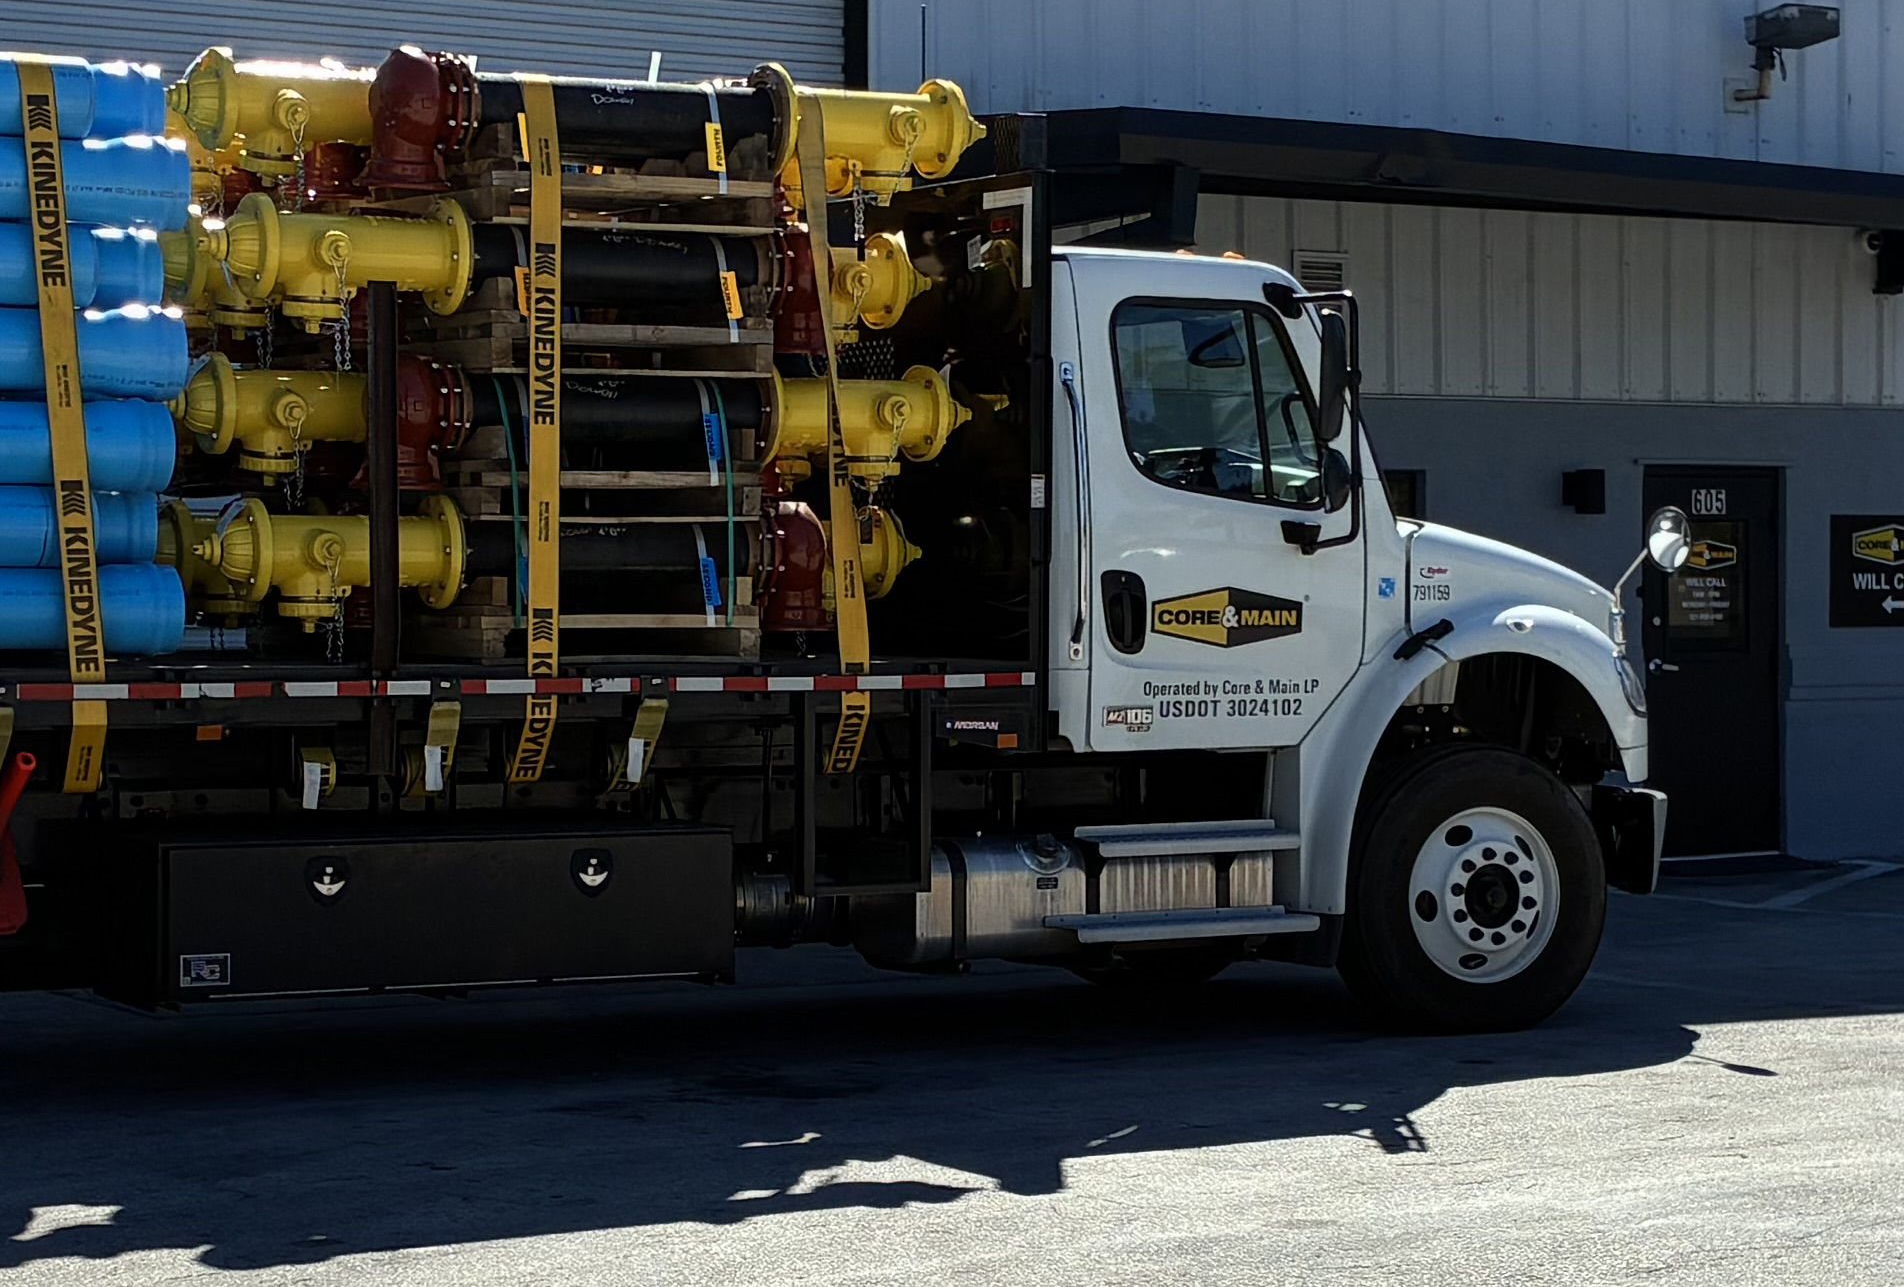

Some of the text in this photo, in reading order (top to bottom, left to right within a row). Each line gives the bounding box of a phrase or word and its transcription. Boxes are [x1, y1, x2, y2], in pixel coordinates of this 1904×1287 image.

[30, 141, 66, 287] KINEDYNE
[534, 287, 556, 426] KINEDYNE
[1695, 490, 1724, 513] 605
[1853, 572, 1890, 590] WILL
[64, 526, 100, 674] KINEDYNE
[1413, 584, 1450, 601] 791159
[1143, 679, 1319, 699] Operated by Core & Main LP
[1126, 709, 1152, 724] 106
[1159, 699, 1302, 718] USDOT 3024102
